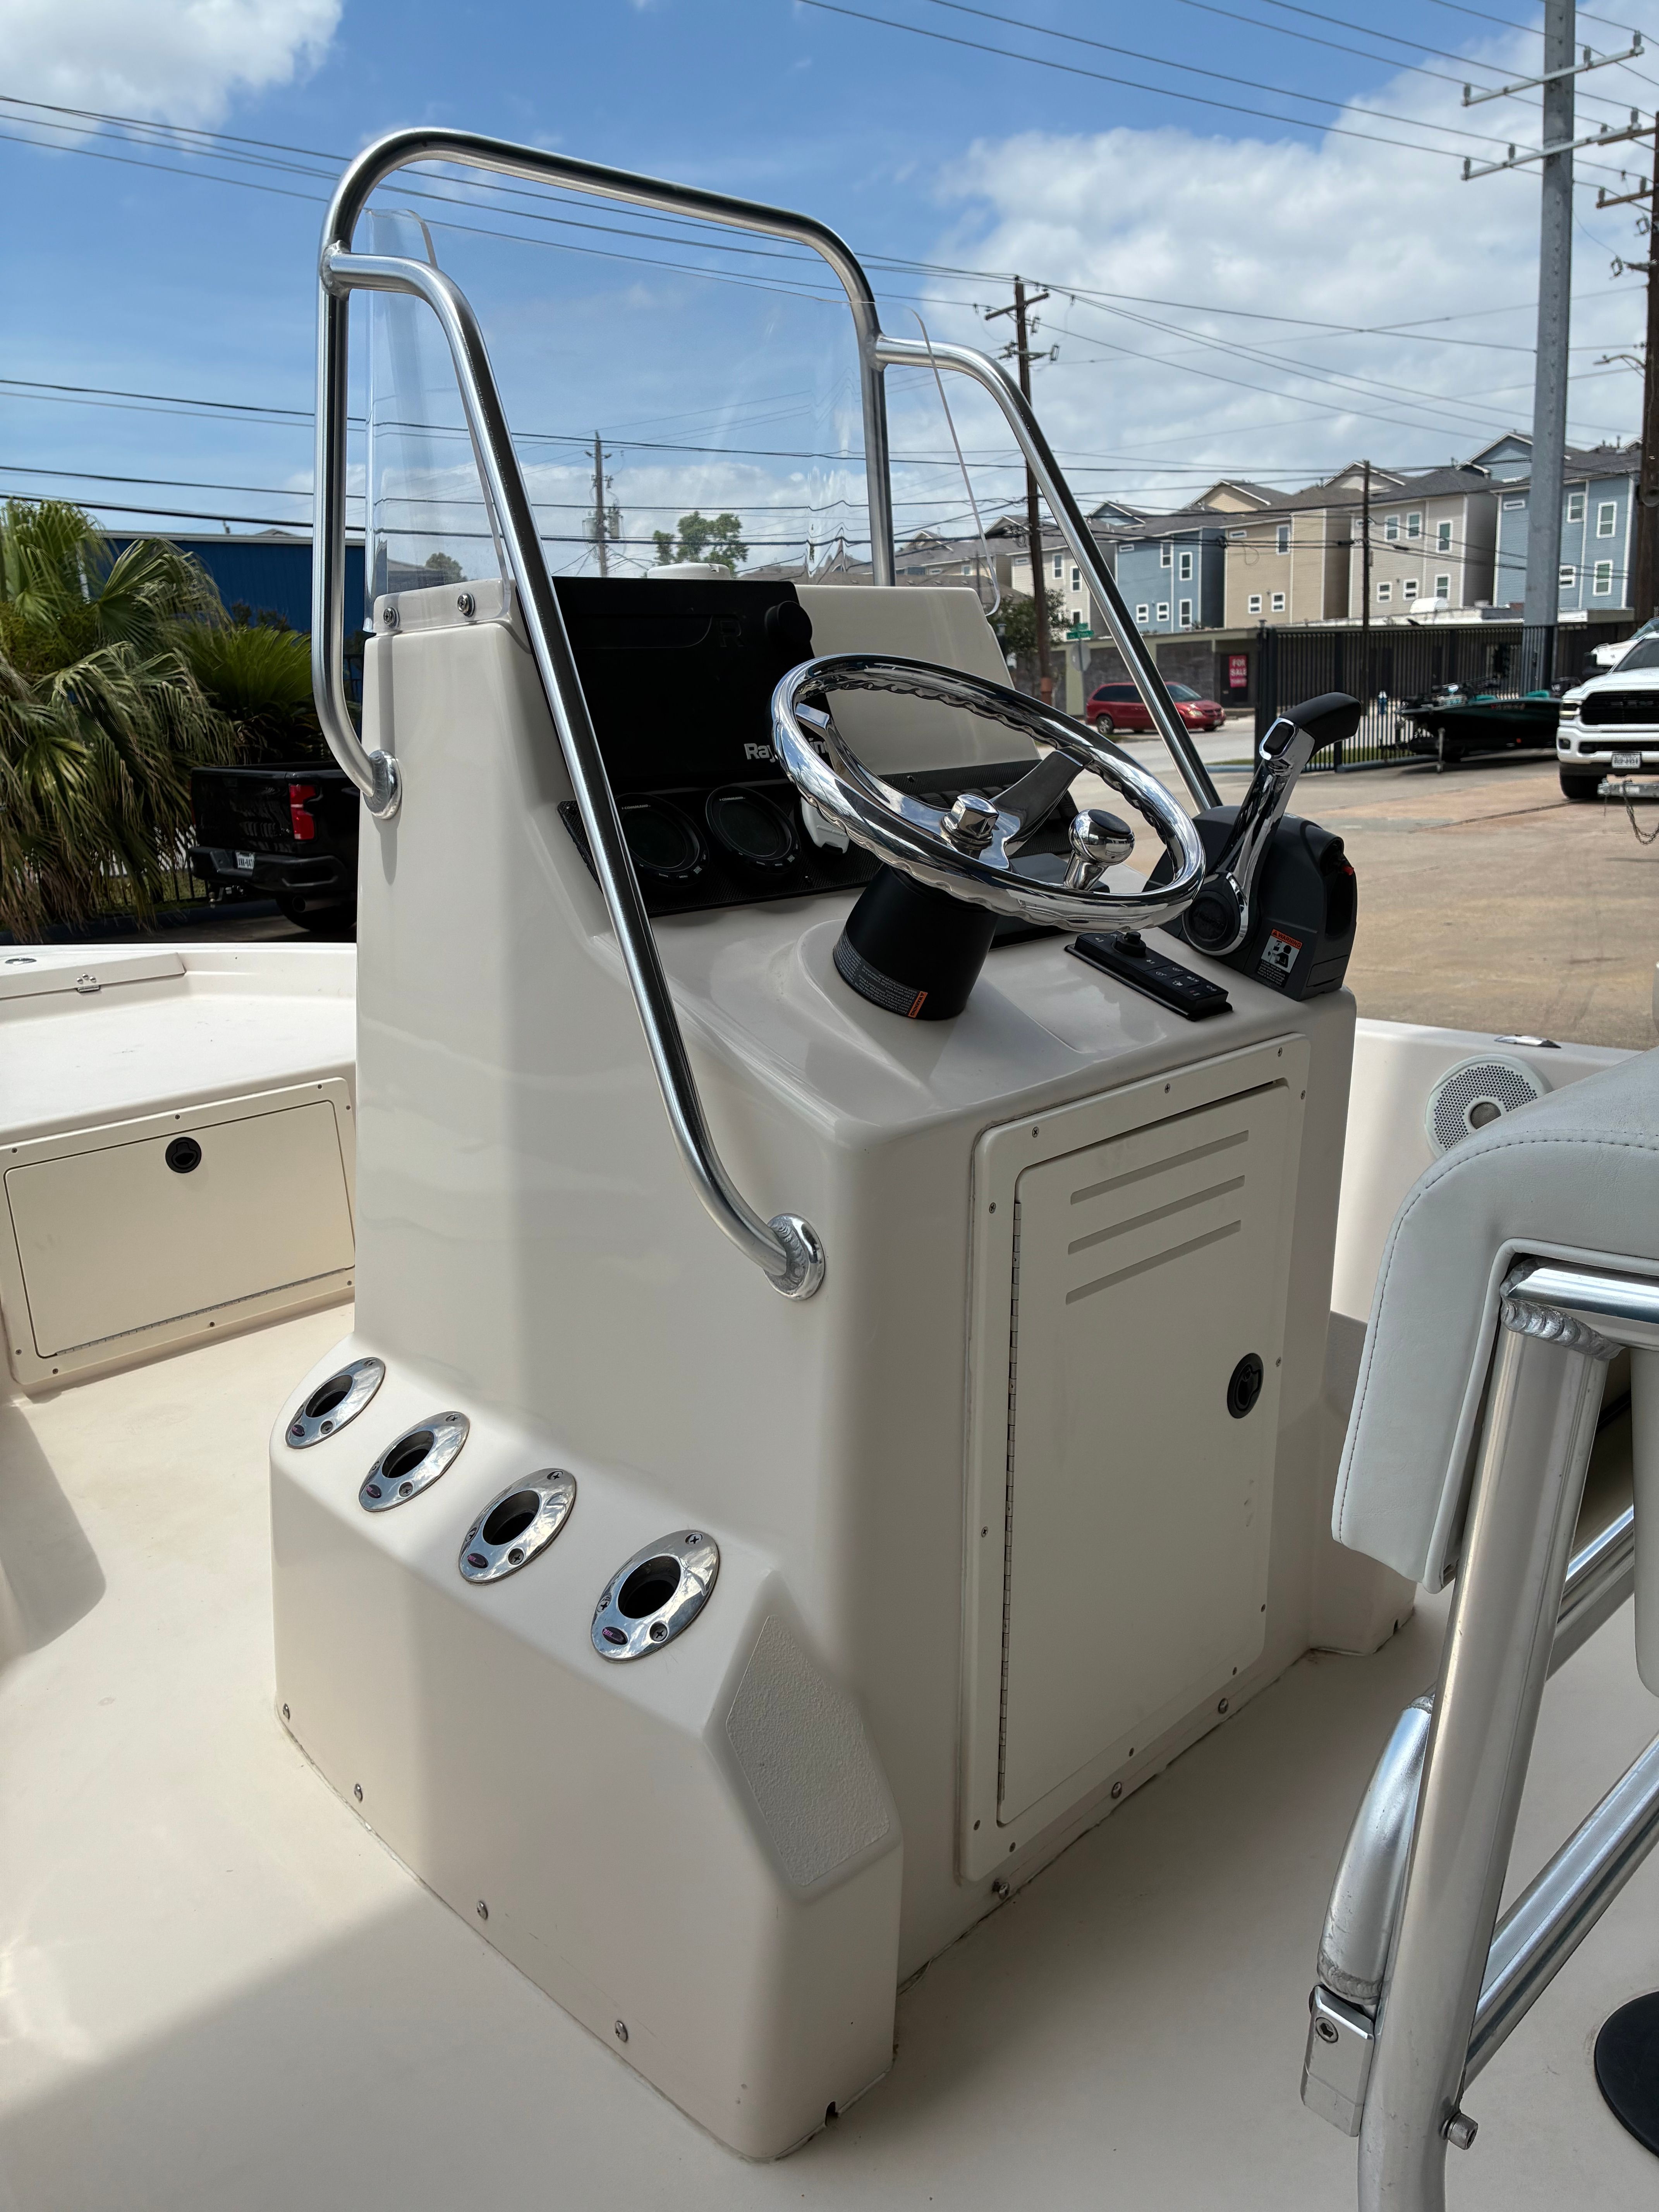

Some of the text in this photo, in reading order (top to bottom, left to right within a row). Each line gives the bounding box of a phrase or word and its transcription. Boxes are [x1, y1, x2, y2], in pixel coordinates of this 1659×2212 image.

[1230, 668, 1247, 676] SALE
[1278, 933, 1301, 948] WARNING
[910, 996, 924, 1016] WARNING
